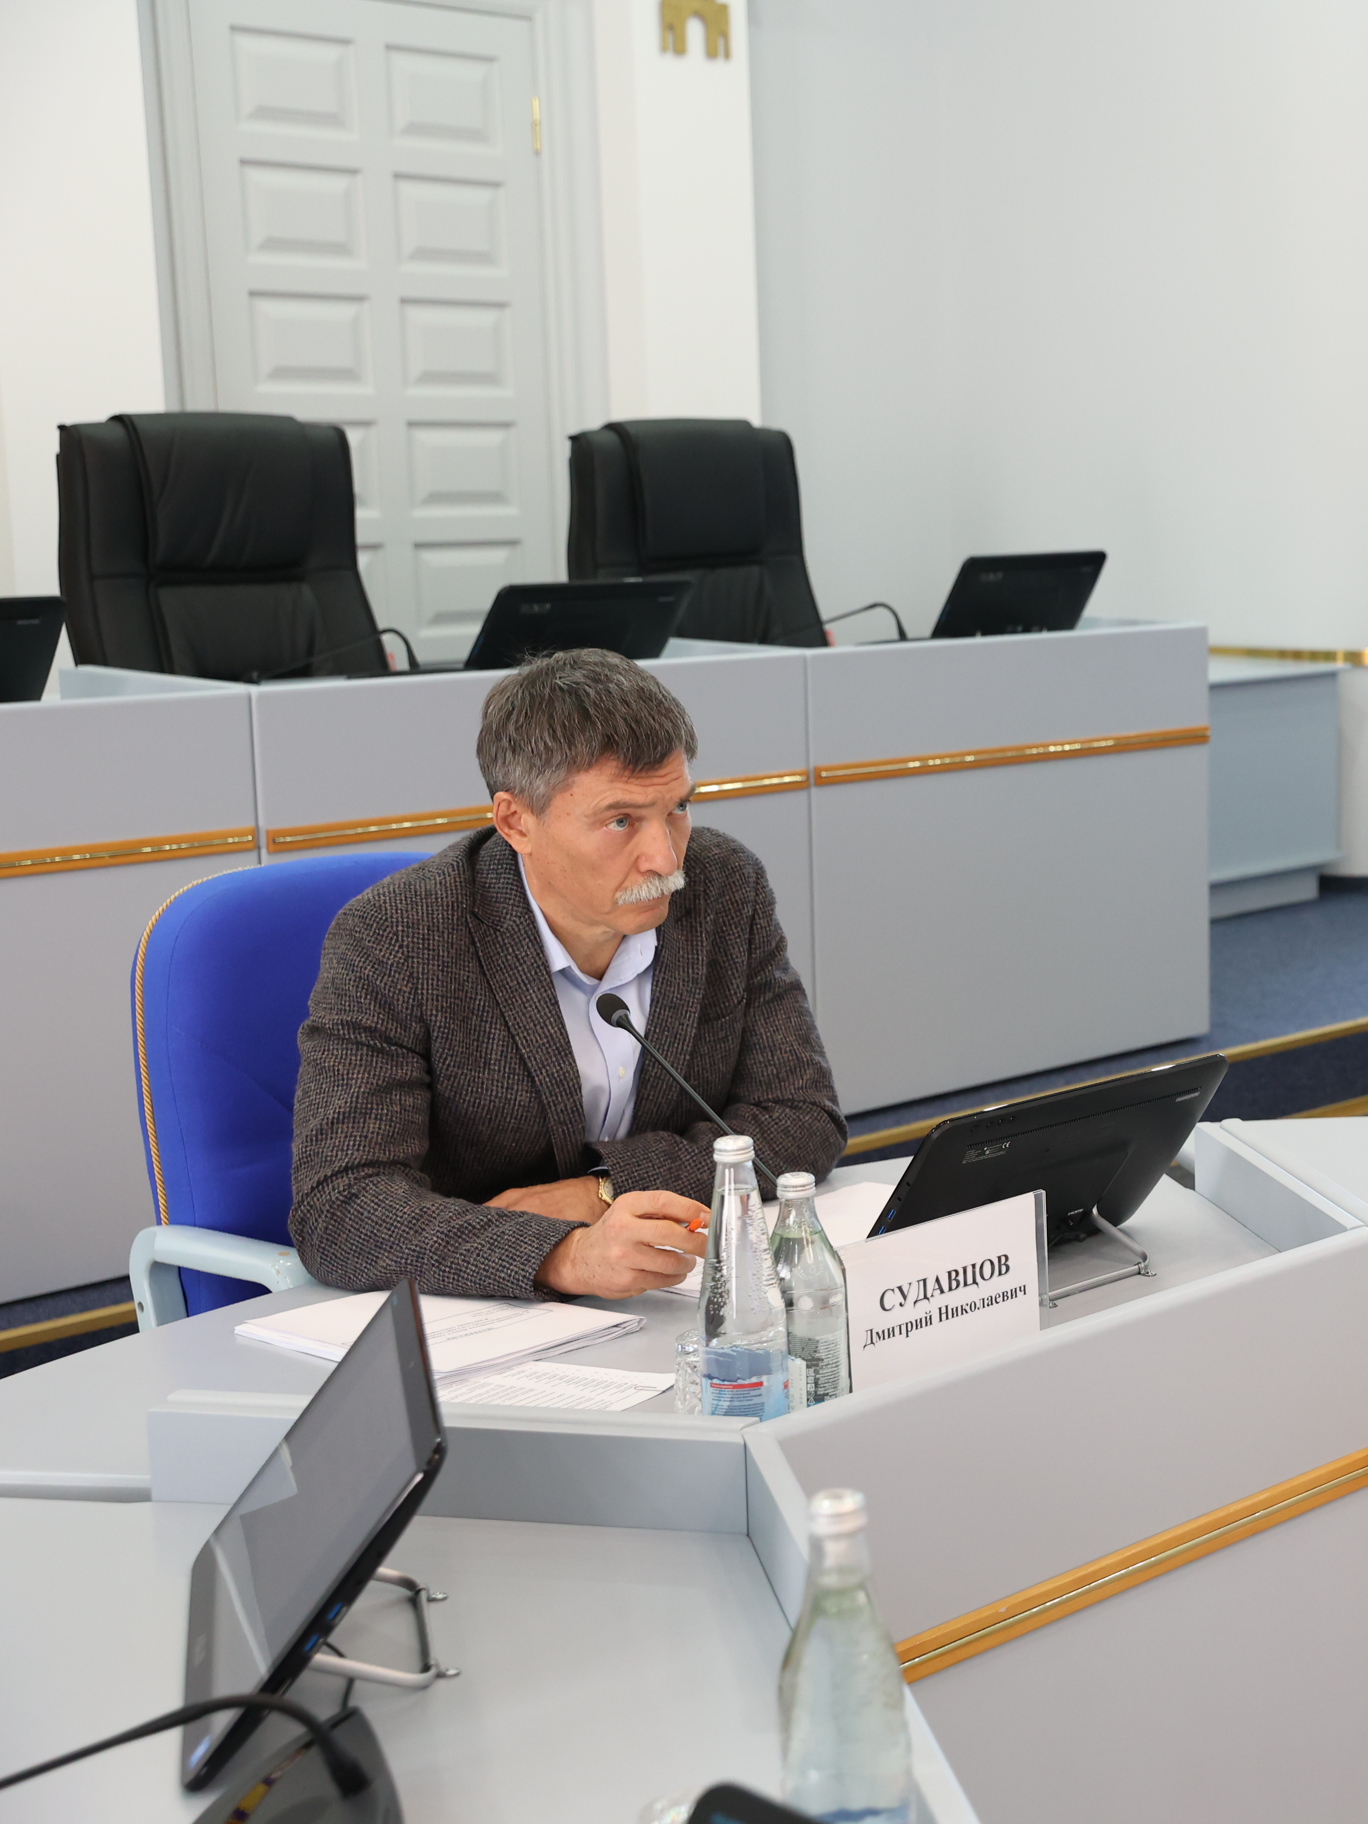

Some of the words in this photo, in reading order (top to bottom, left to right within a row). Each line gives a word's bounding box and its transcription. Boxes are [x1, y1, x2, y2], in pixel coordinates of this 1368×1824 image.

[879, 1253, 1011, 1312] СУДАВЦОВ
[863, 1311, 933, 1350] Дмитрий
[937, 1284, 1028, 1323] Николаевич
